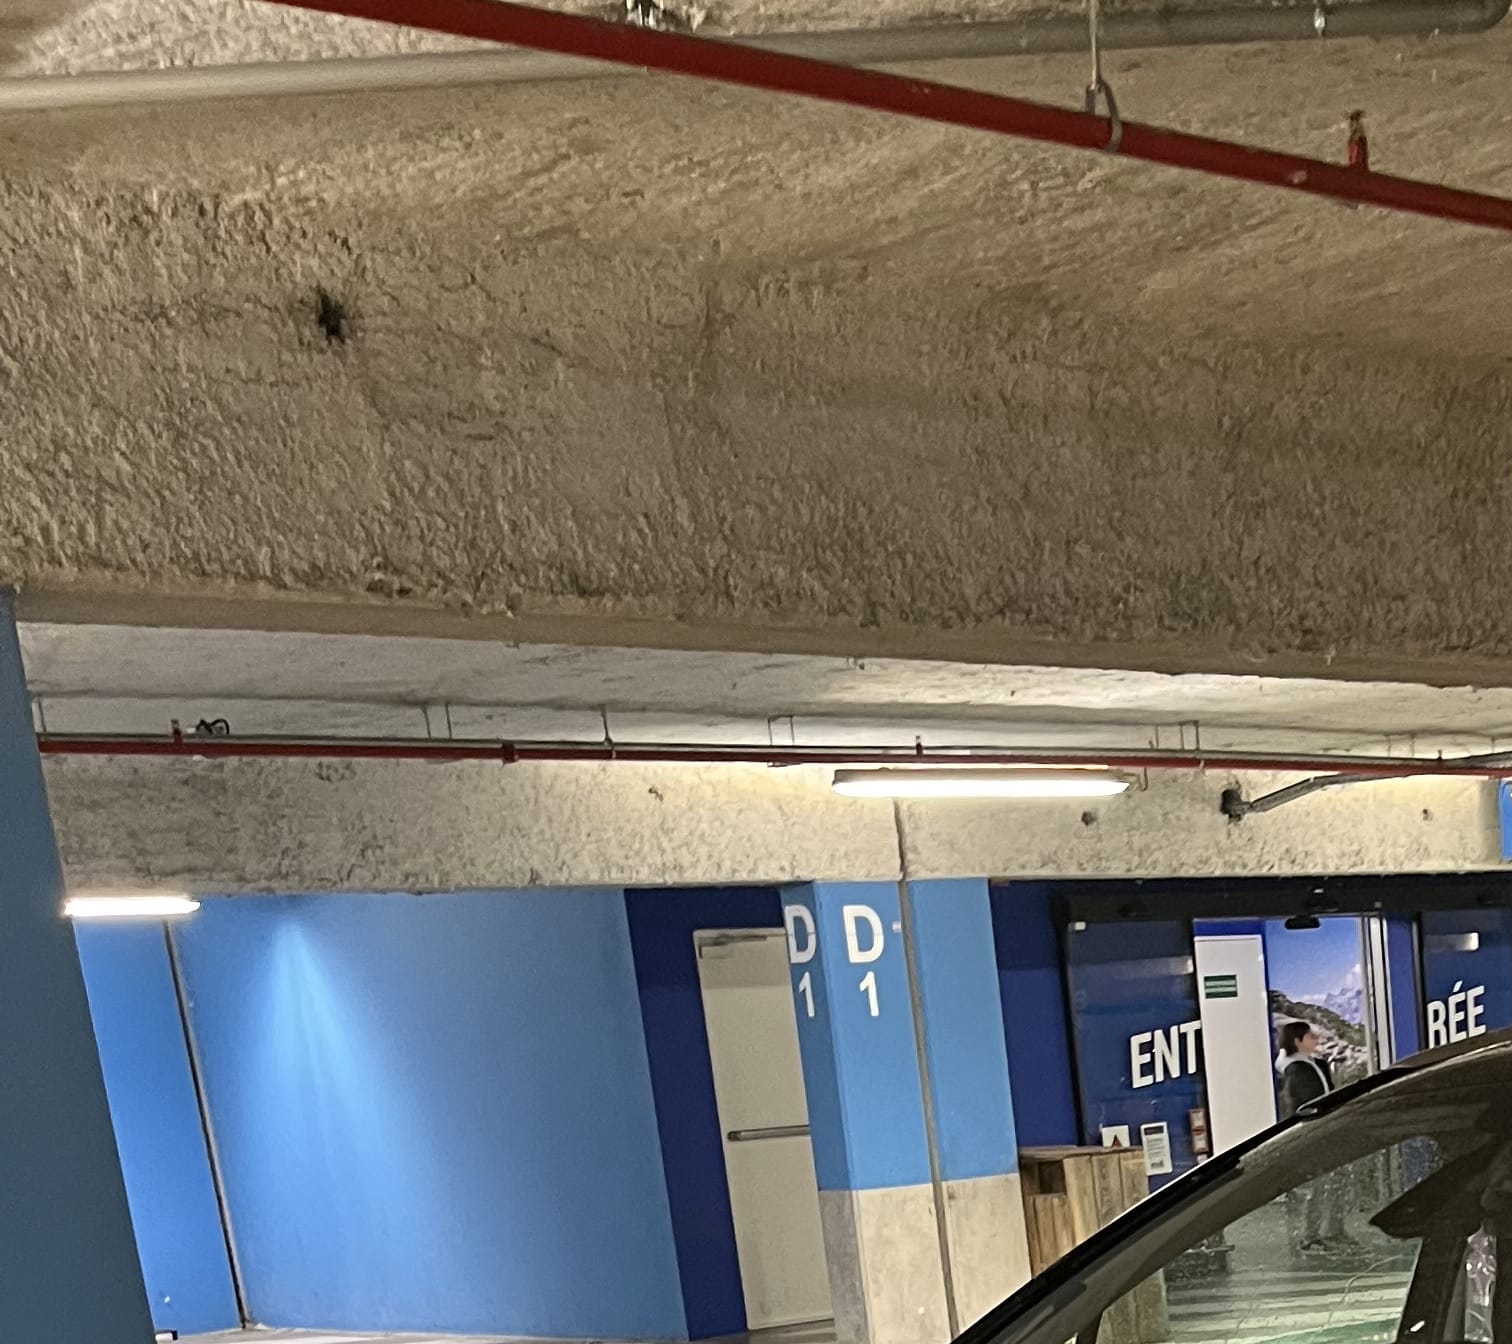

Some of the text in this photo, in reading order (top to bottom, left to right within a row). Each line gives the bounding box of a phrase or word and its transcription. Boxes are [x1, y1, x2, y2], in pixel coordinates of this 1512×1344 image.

[785, 904, 817, 963] D
[843, 904, 884, 963] D
[799, 971, 815, 1017] 1
[859, 971, 879, 1017] 1
[1130, 980, 1486, 1089] ENT RÉE
